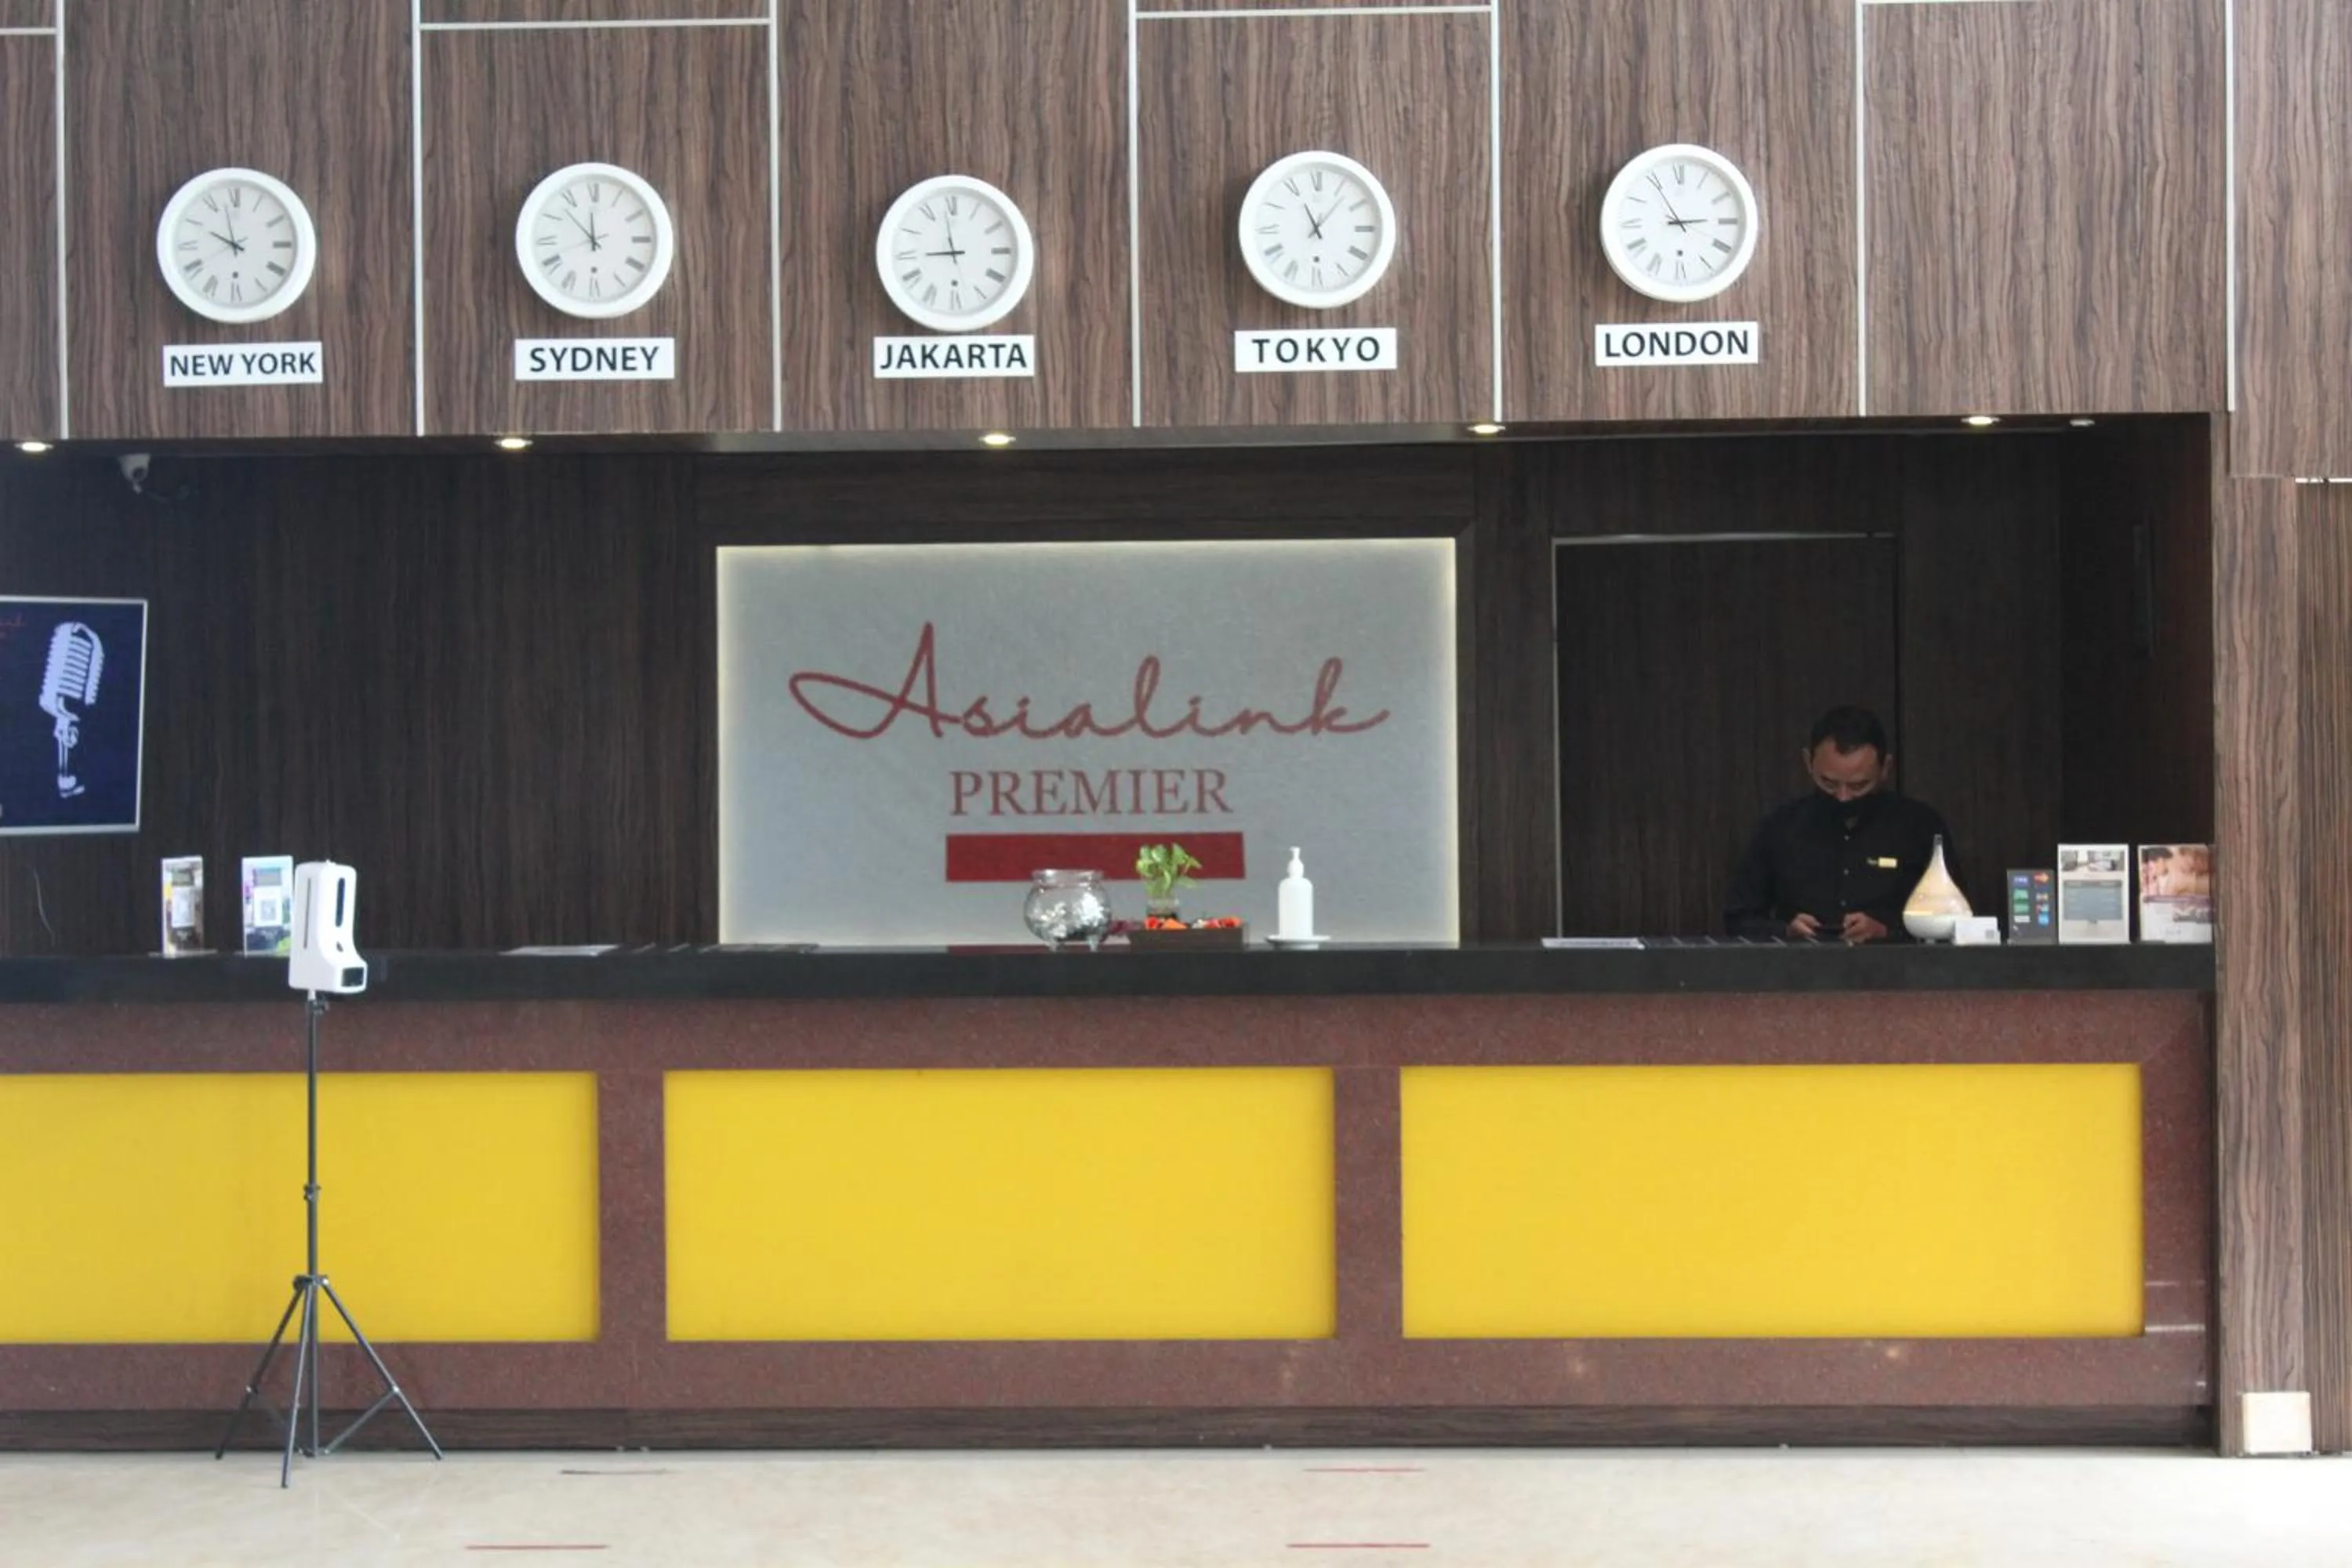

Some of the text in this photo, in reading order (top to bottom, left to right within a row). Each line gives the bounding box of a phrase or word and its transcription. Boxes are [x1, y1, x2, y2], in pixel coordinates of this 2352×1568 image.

[880, 343, 1028, 370] JAKARTA
[1251, 336, 1381, 364] TOKYO
[1605, 330, 1749, 358] LONDON
[170, 351, 317, 377] NEW YORK
[529, 346, 659, 372] SYDNEY
[788, 622, 1390, 739] Asialink
[949, 768, 1234, 816] PREMIER
